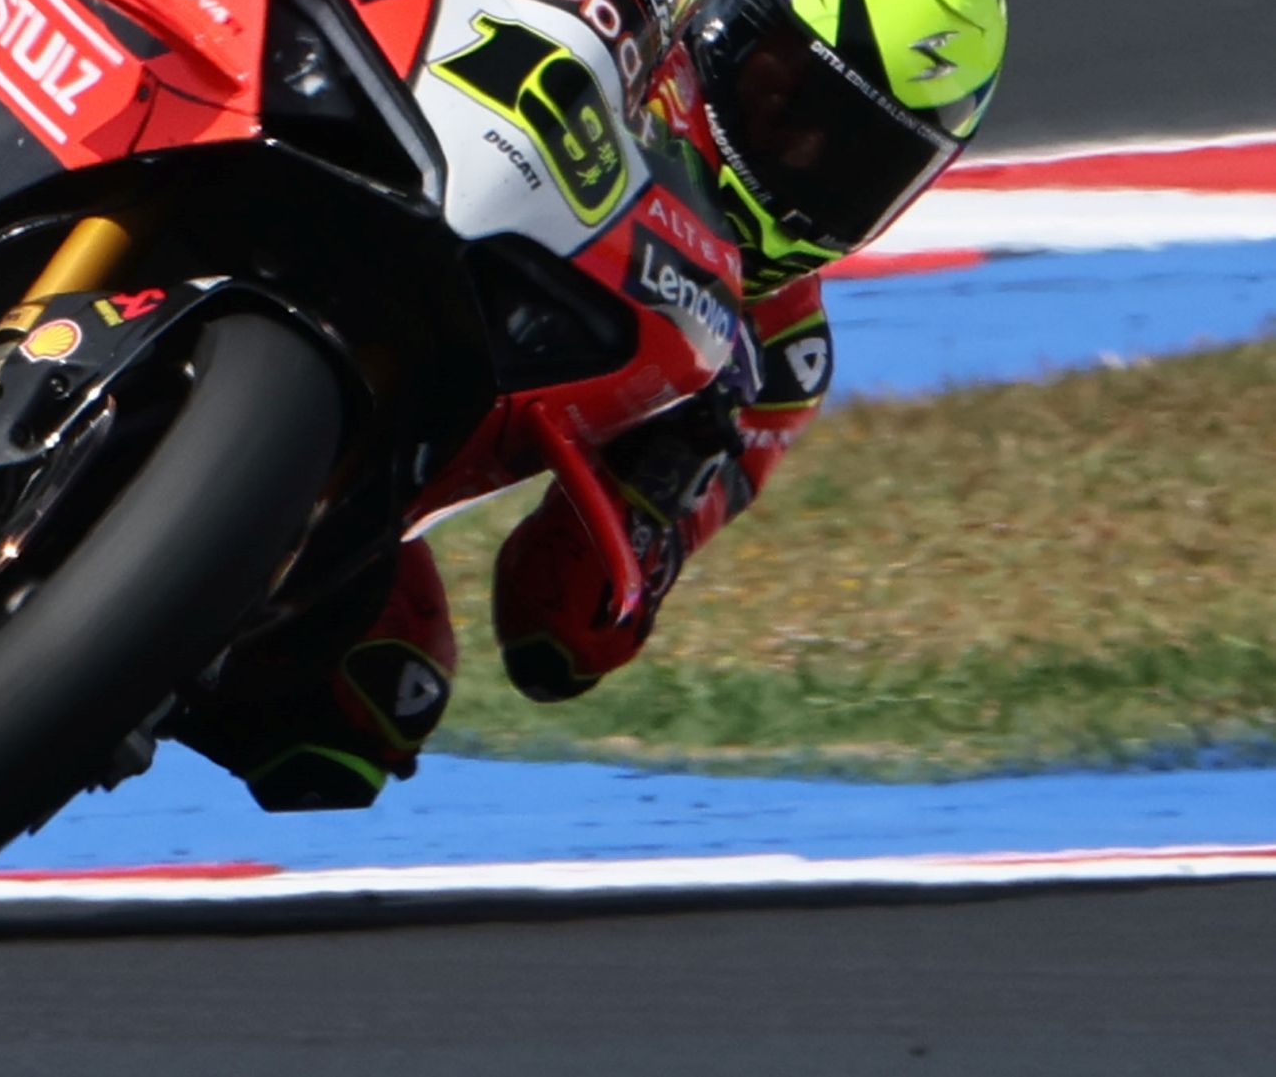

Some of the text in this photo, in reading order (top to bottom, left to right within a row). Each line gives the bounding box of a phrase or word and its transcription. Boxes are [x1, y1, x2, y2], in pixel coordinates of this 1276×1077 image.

[430, 11, 628, 228] 19
[483, 130, 543, 191] DUCATI
[640, 244, 736, 345] Lenovo
